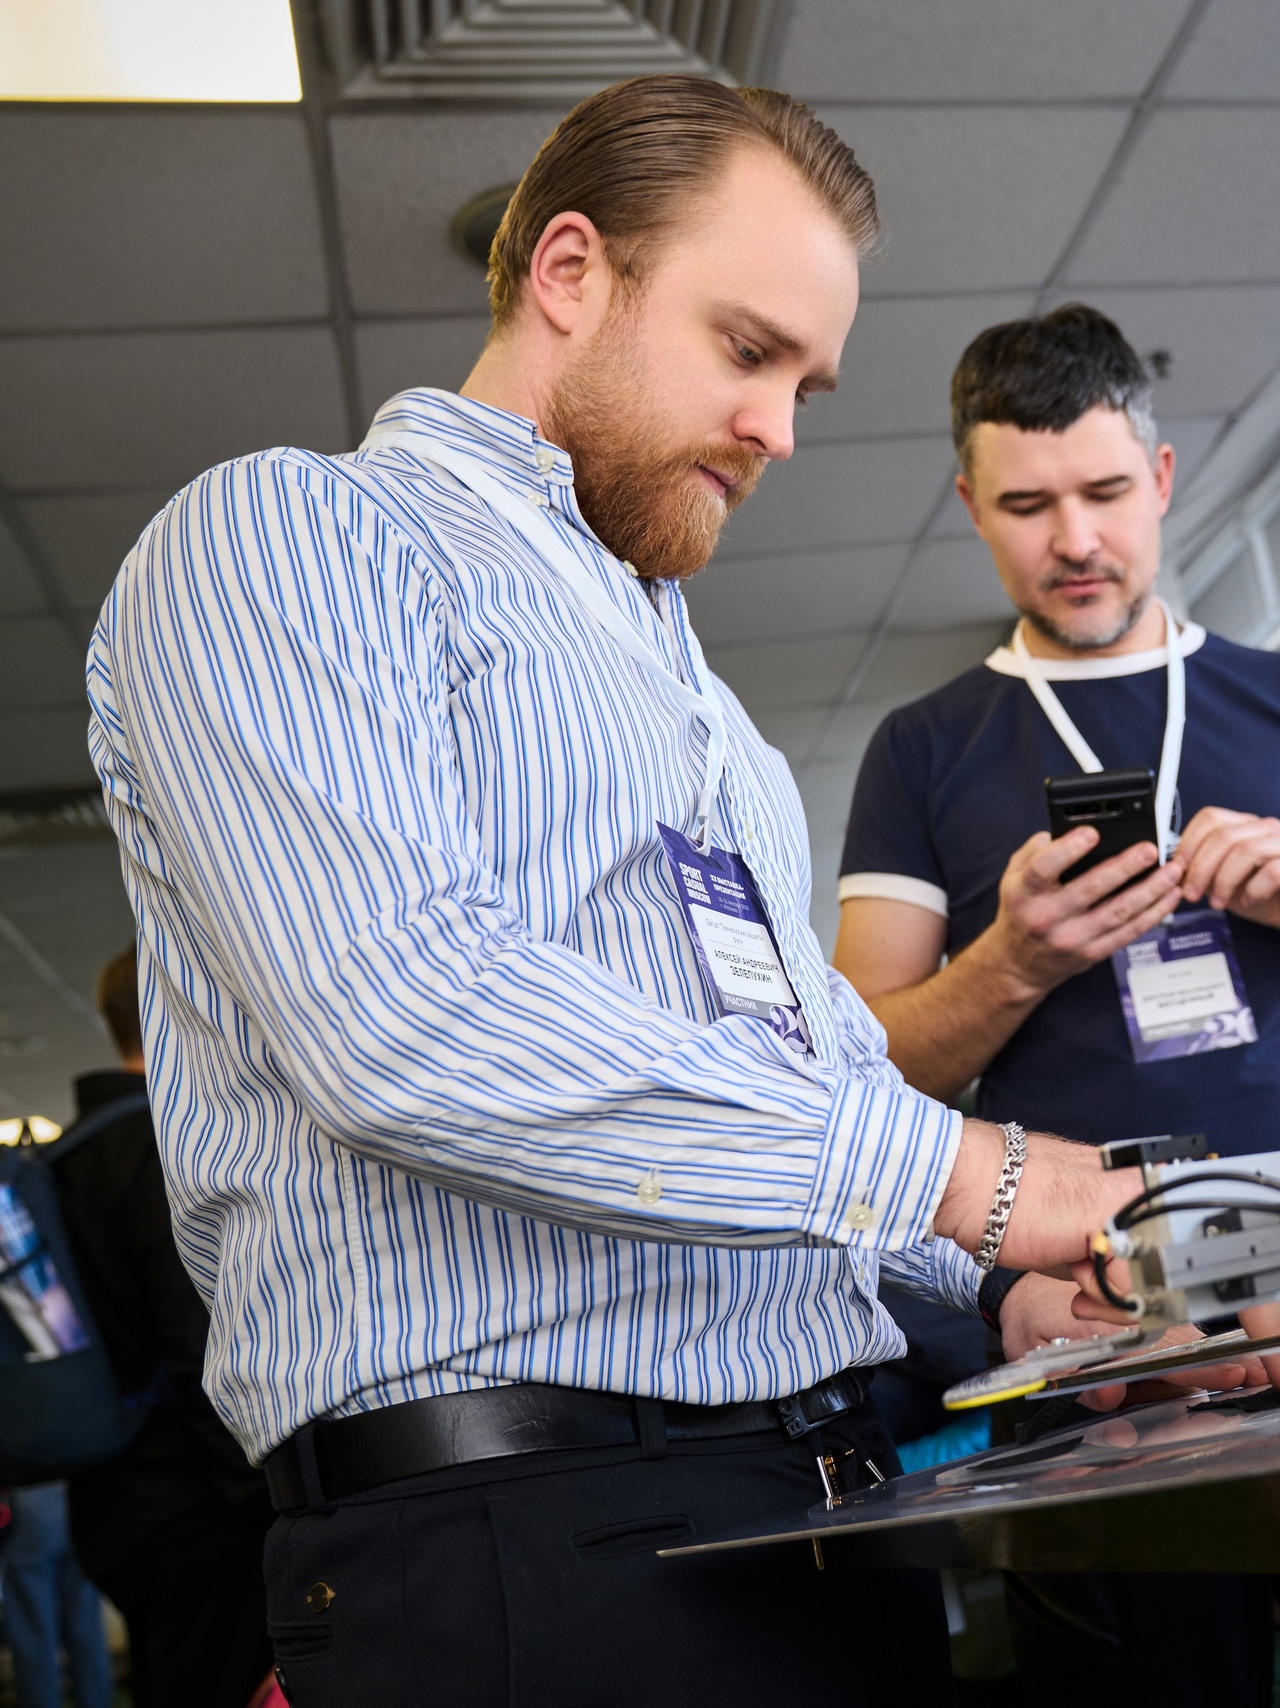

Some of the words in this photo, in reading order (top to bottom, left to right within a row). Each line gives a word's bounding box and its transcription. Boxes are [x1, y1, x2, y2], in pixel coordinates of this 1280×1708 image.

[679, 862, 703, 882] SPORT
[683, 876, 709, 894] CASUAL
[687, 887, 712, 904] MOSCOW
[714, 949, 741, 964] АЛЕКСЕЙ
[742, 957, 779, 972] АНДРЕЕВИЧ
[730, 965, 772, 983] ЗЕЛЕПУХИН
[723, 994, 759, 1011] УЧАСТНИК
